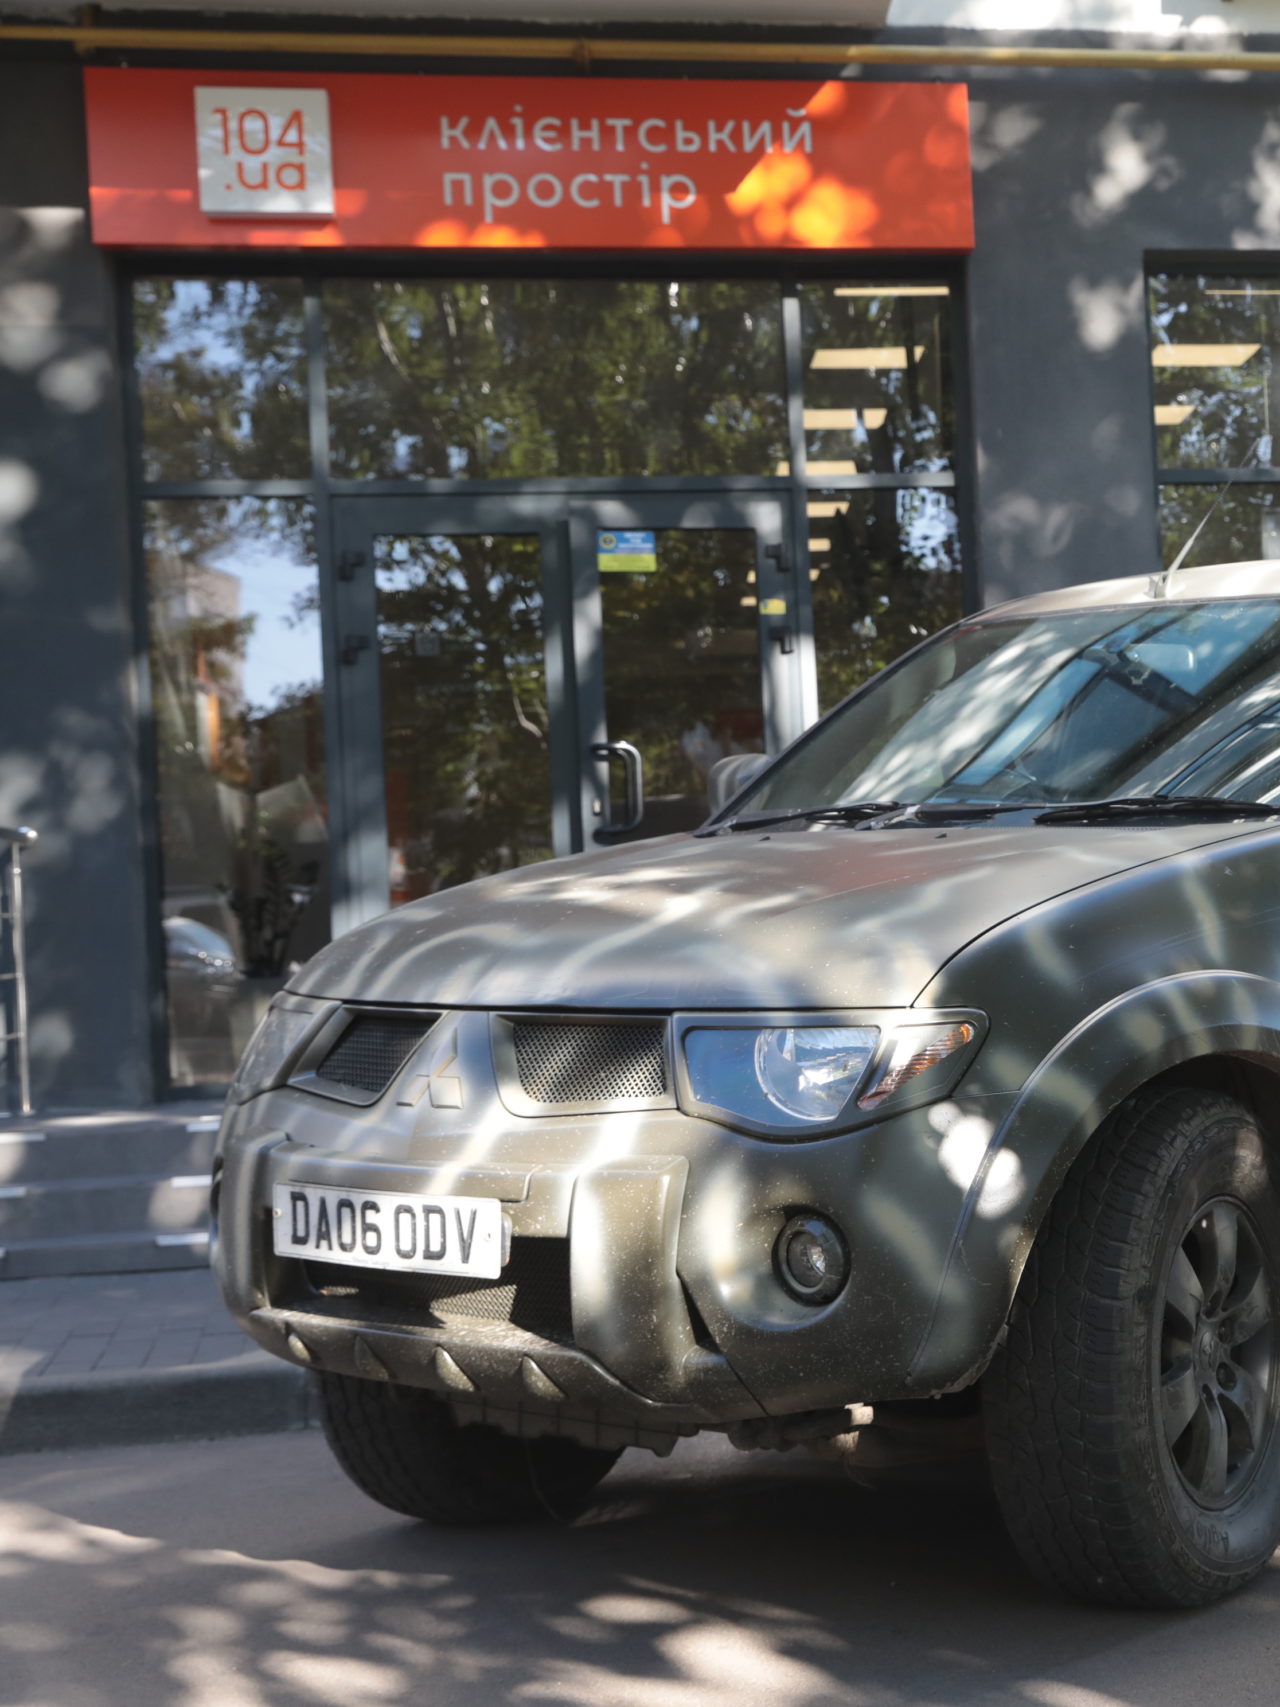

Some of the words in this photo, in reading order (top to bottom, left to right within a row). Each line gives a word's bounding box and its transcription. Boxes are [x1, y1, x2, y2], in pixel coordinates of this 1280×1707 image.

[212, 107, 306, 156] 104
[440, 105, 813, 154] клієнтський
[225, 161, 306, 192] .ua
[442, 162, 698, 225] простір
[290, 1191, 381, 1255] DA06
[394, 1204, 478, 1264] ODV
